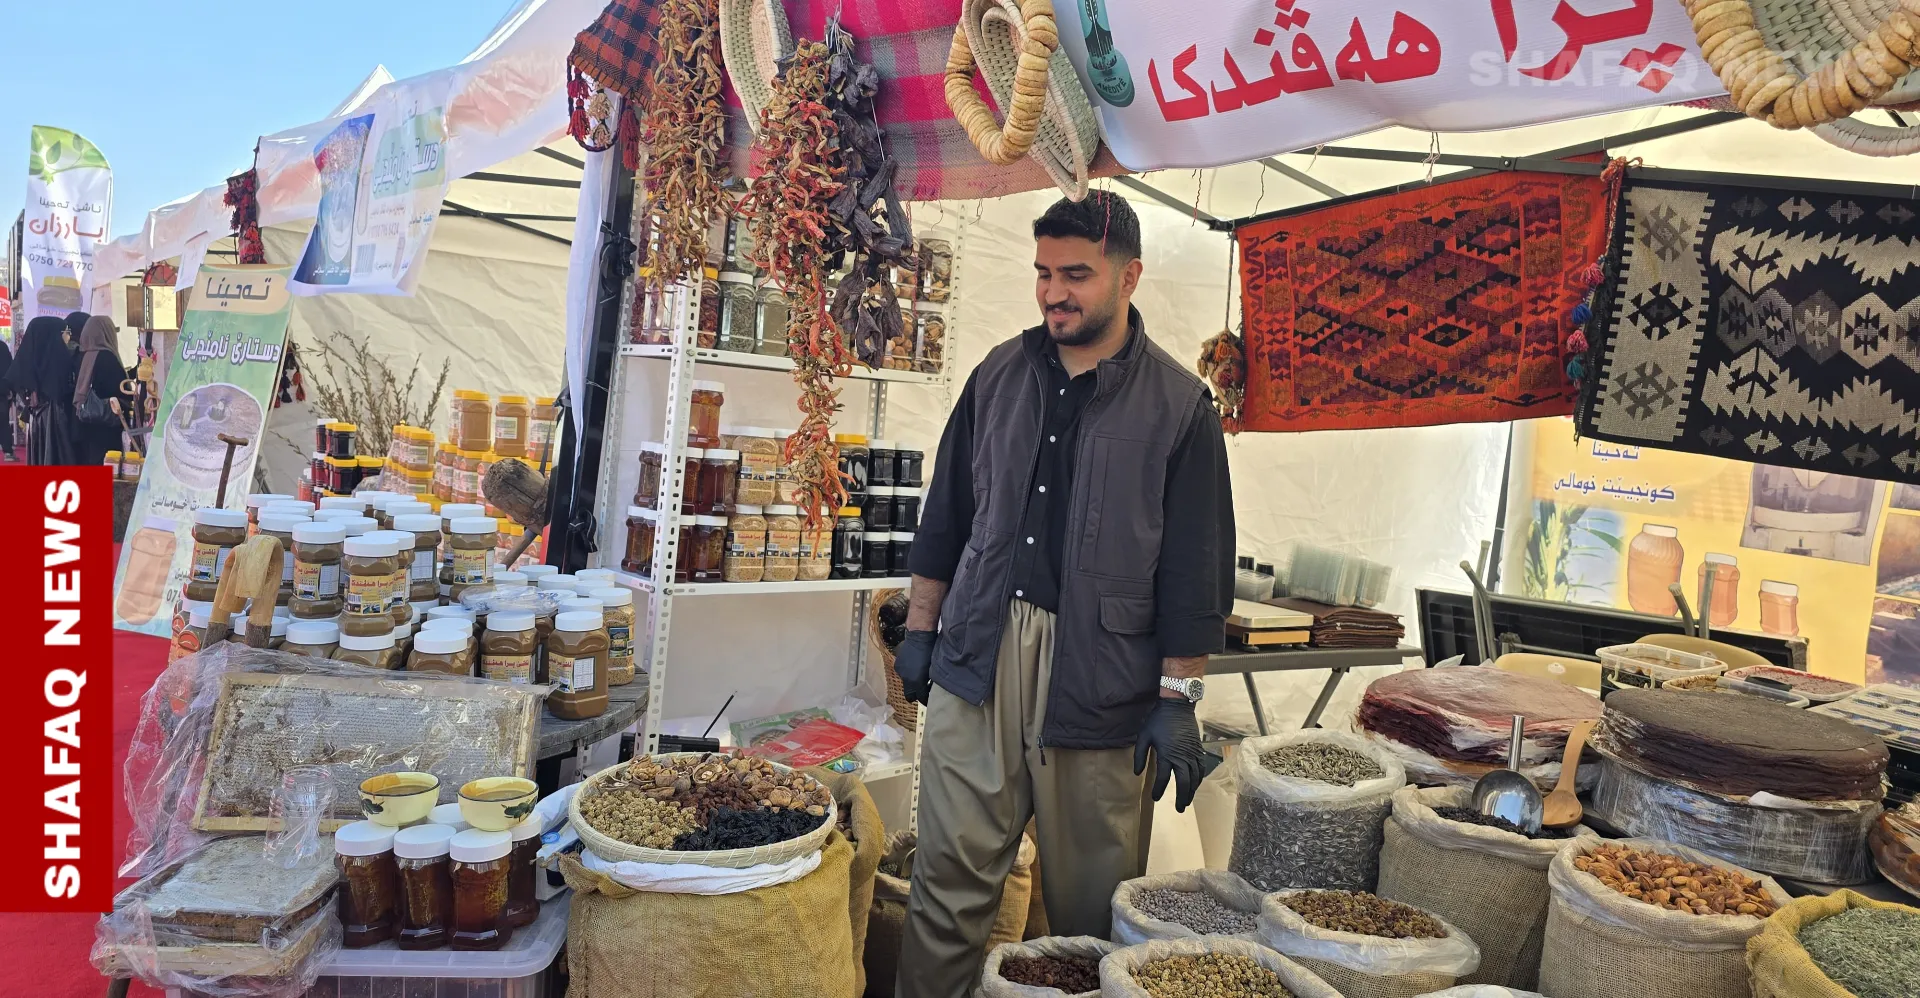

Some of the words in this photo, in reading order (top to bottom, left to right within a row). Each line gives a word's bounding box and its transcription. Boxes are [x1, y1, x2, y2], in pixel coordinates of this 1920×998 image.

[28, 212, 103, 243] بارزان
[29, 253, 54, 266] 0750
[206, 277, 272, 307] تەحینا
